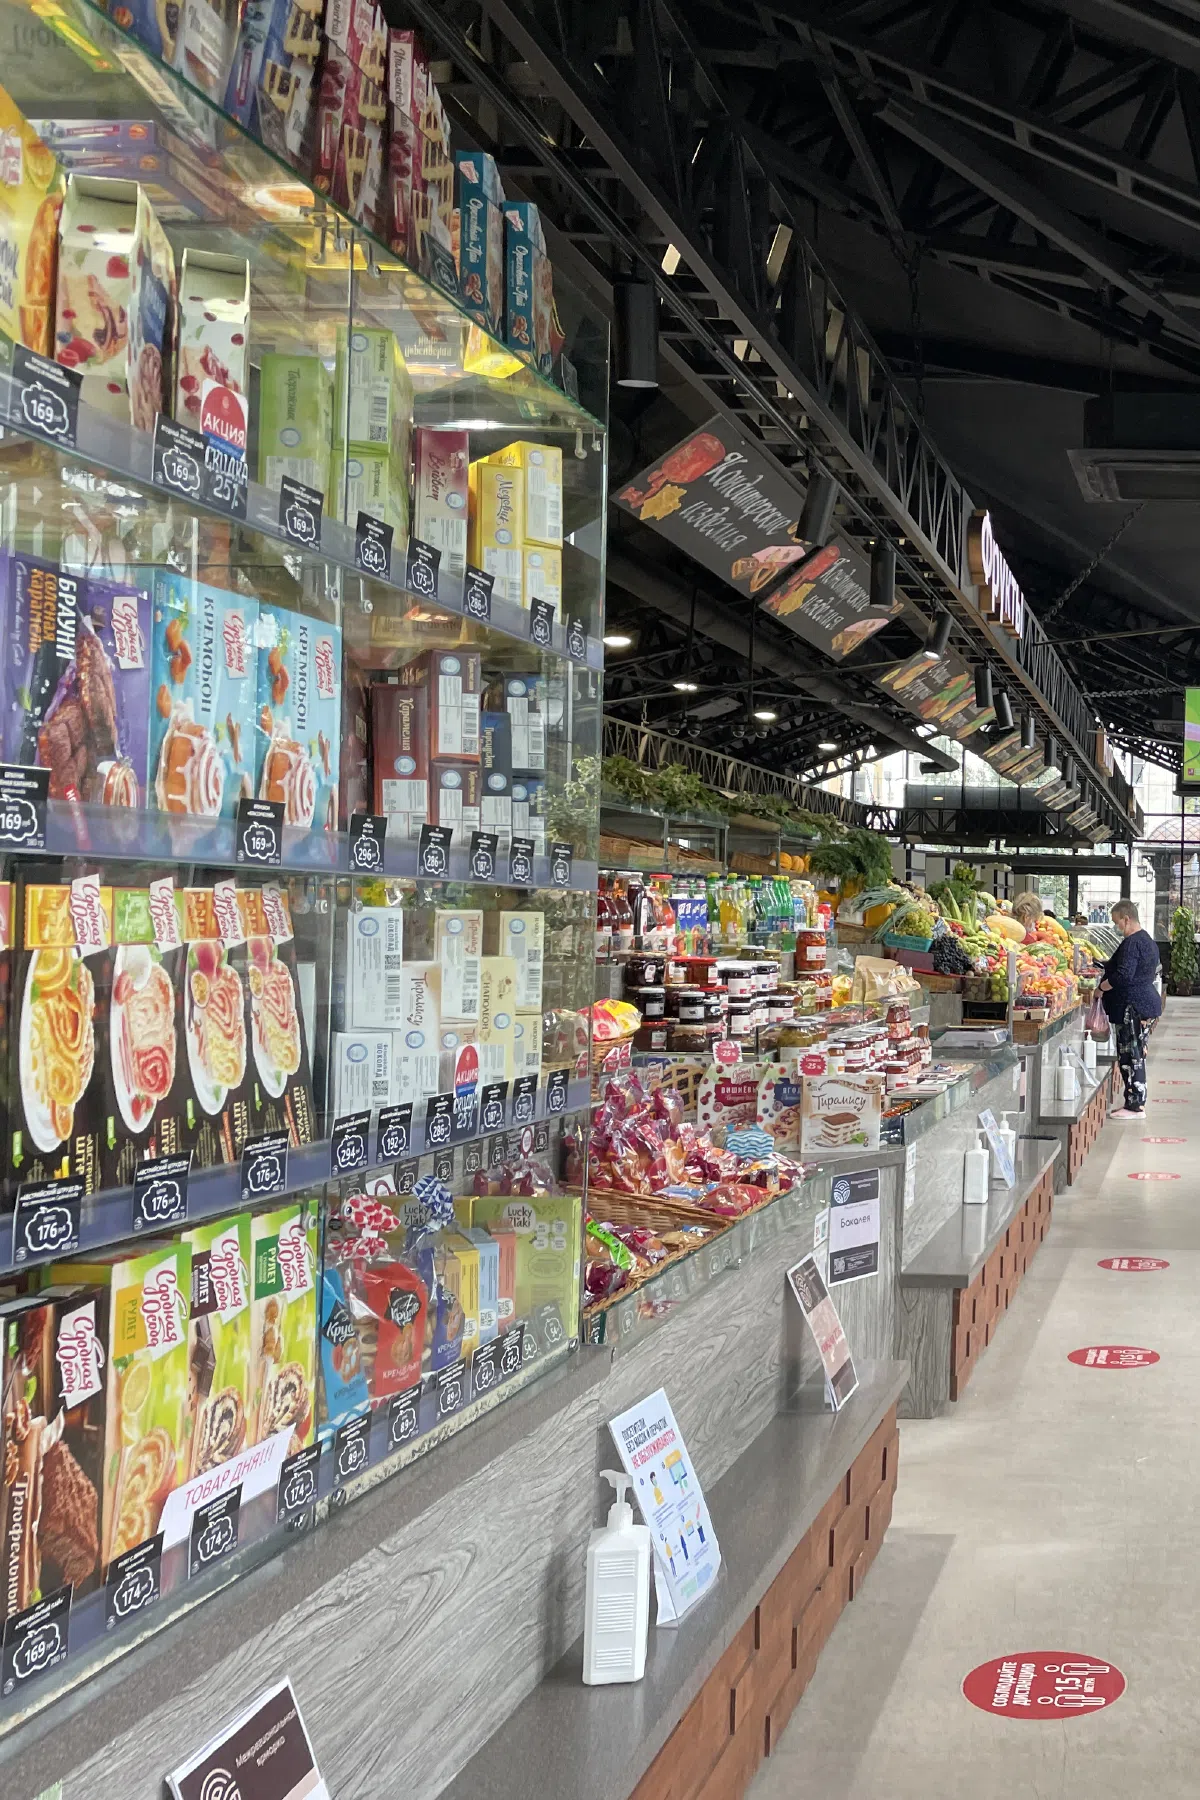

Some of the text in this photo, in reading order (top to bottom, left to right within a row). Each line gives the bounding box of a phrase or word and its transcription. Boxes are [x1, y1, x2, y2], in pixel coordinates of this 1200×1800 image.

[31, 399, 54, 423] 169
[204, 412, 245, 447] АКЦИЯ
[172, 462, 189, 481] 169
[705, 451, 793, 536] Кондитерские
[293, 516, 308, 533] 169
[679, 499, 748, 553] изделия
[363, 547, 379, 565] 264
[416, 571, 428, 587] 175
[28, 568, 45, 653] карамель
[43, 572, 58, 641] соленая
[56, 577, 78, 660] БРАУНИ
[201, 596, 214, 713] КРЕМОБОН
[297, 625, 308, 731] КРЕМОБОН
[399, 697, 414, 751] Карамелия
[0, 813, 22, 830] 169
[251, 836, 267, 851] 169
[358, 848, 372, 861] 296
[427, 855, 439, 869] 286
[406, 971, 429, 1027] Тирамису
[482, 981, 490, 1032] НАПОЛЕОН
[455, 1067, 479, 1084] АКЦИЯ
[806, 1062, 817, 1070] -25
[811, 1093, 867, 1111] Тирамису
[386, 1135, 399, 1150] 192
[432, 1124, 444, 1138] 286
[341, 1142, 356, 1159] 294
[256, 1168, 270, 1183] 176
[151, 1195, 168, 1211] 176
[404, 1204, 429, 1217] Lucky
[507, 1206, 532, 1218] Lucky
[37, 1222, 58, 1241] 176
[840, 1214, 871, 1229] Бакалея
[267, 1246, 277, 1285] РУЛЕТ
[278, 1223, 308, 1289] Сдобная
[212, 1238, 243, 1307] Сдобная
[277, 1249, 294, 1292] Особа
[198, 1263, 209, 1304] РУЛЕТ
[209, 1266, 229, 1311] Особа
[146, 1269, 179, 1343] Сдобная
[126, 1298, 138, 1341] РУЛЕТ
[141, 1299, 160, 1348] Особа
[62, 1315, 99, 1390] Сдобная
[56, 1345, 78, 1395] Особа
[446, 1389, 455, 1404] 89
[400, 1419, 410, 1434] 89
[348, 1450, 358, 1466] 89
[184, 1468, 230, 1510] ТОВАР
[231, 1442, 275, 1484] ДНЯ!!!
[290, 1482, 304, 1499] 174
[6, 1471, 30, 1618] Трюфельный
[205, 1533, 222, 1553] 174
[122, 1582, 141, 1606] 174
[25, 1641, 46, 1664] 169
[992, 1661, 1018, 1707] СОБЛЮДАЙТЕ
[1013, 1663, 1038, 1707] ДИСТАНЦИЮ
[1054, 1677, 1083, 1692] 1,5
